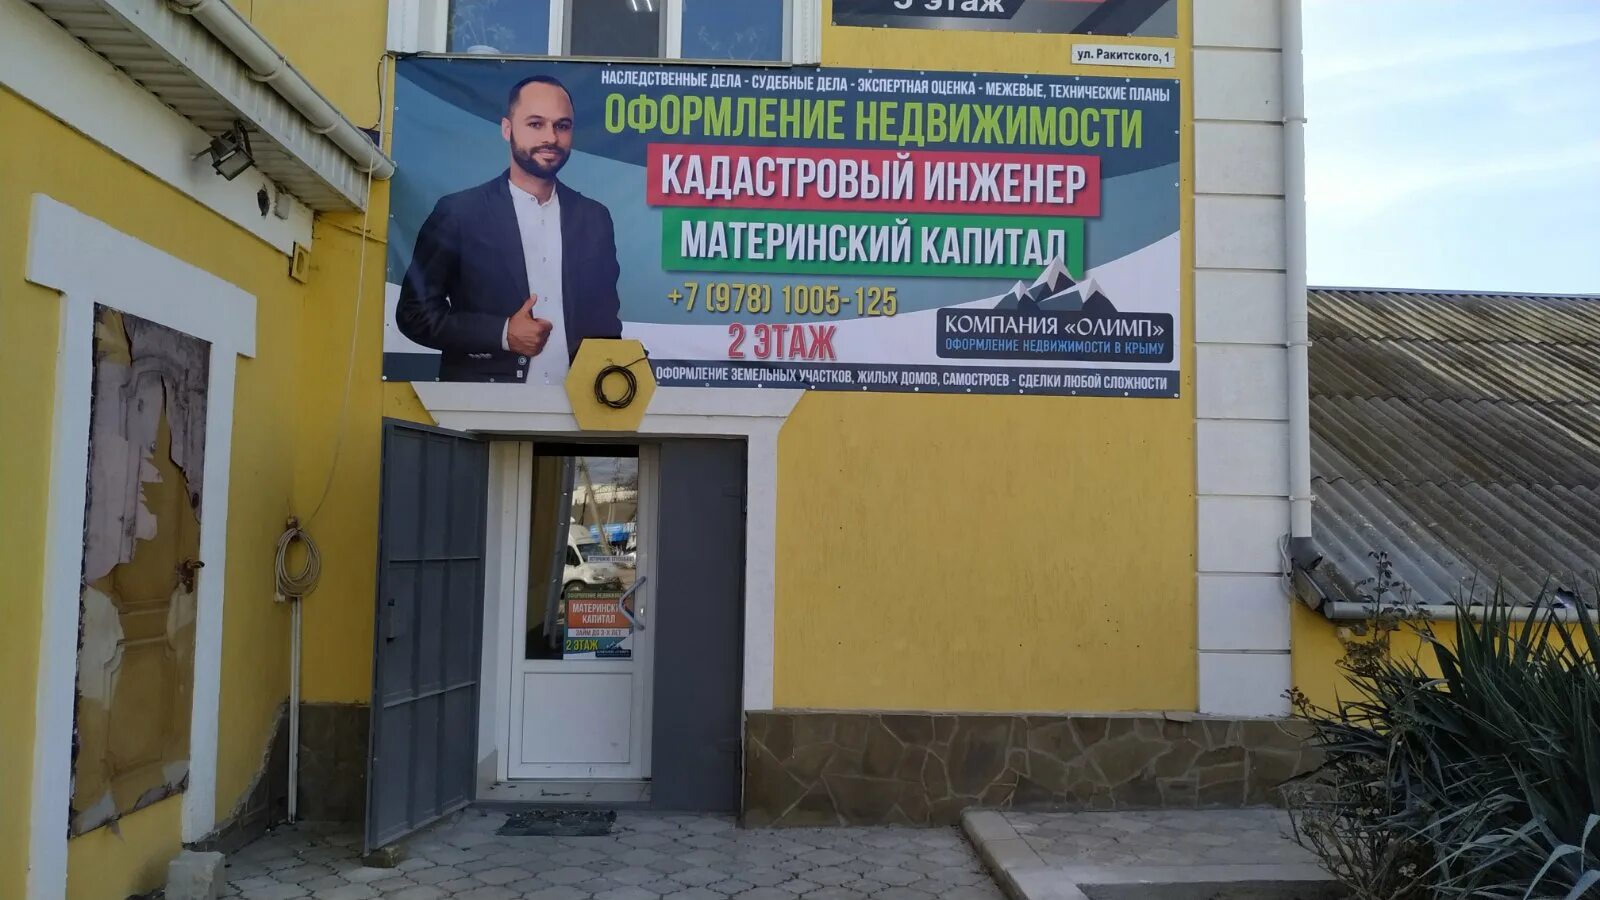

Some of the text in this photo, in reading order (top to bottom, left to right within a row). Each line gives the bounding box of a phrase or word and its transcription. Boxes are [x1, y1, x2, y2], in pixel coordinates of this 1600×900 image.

[1078, 48, 1170, 64] ул. Ракитского, 1
[602, 71, 707, 86] НАСЛЕДСТВЕННЫЕ
[710, 73, 741, 88] ДЕЛА
[752, 74, 814, 91] СУДЕБНЫЕ
[817, 76, 847, 92] ДЕЛА
[858, 78, 929, 93] ЭКСПЕРТНАЯ
[931, 80, 975, 96] ОЦЕНКА
[986, 82, 1046, 99] МЕЖЕВЫЕ,
[1050, 84, 1126, 100] ТЕХНИЧЕСКИЕ
[1129, 87, 1170, 101] ПЛАНЫ
[605, 93, 1142, 148] ОФОРМЛЕНИЕ НЕДВИЖИМОСТИ
[662, 152, 1086, 204] КАДАСТРОВЫЙ ИНЖЕНЕР
[680, 217, 1065, 266] МАТЕРИНСКИЙ КАПИТАЛ
[667, 282, 897, 316] +7 (978) 1005-125
[946, 315, 1164, 337] КОМПАНИЯ «ОЛИМП»
[728, 323, 837, 360] 2 ЭТАЖ
[946, 338, 1164, 354] ОФОРМЛЕНИЕ НЕДВИЖИМОСТИ В КРЫМУ
[656, 366, 728, 380] ОФОРМЛЕНИЕ
[731, 368, 796, 382] ЗЕМЕЛЬНЫХ
[799, 369, 855, 384] УЧАСТКОВ,
[857, 370, 897, 384] ЖИЛЫХ
[900, 371, 940, 386] ДОМОВ,
[943, 372, 1009, 386] САМОСТРОЕВ
[1019, 374, 1061, 388] СДЕЛКИ
[1064, 373, 1101, 388] ЛЮБОЙ
[1104, 375, 1167, 389] СЛОЖНОСТИ
[583, 614, 616, 624] КАПИТАЛ
[566, 640, 598, 650] 2 ЭТАЖ
